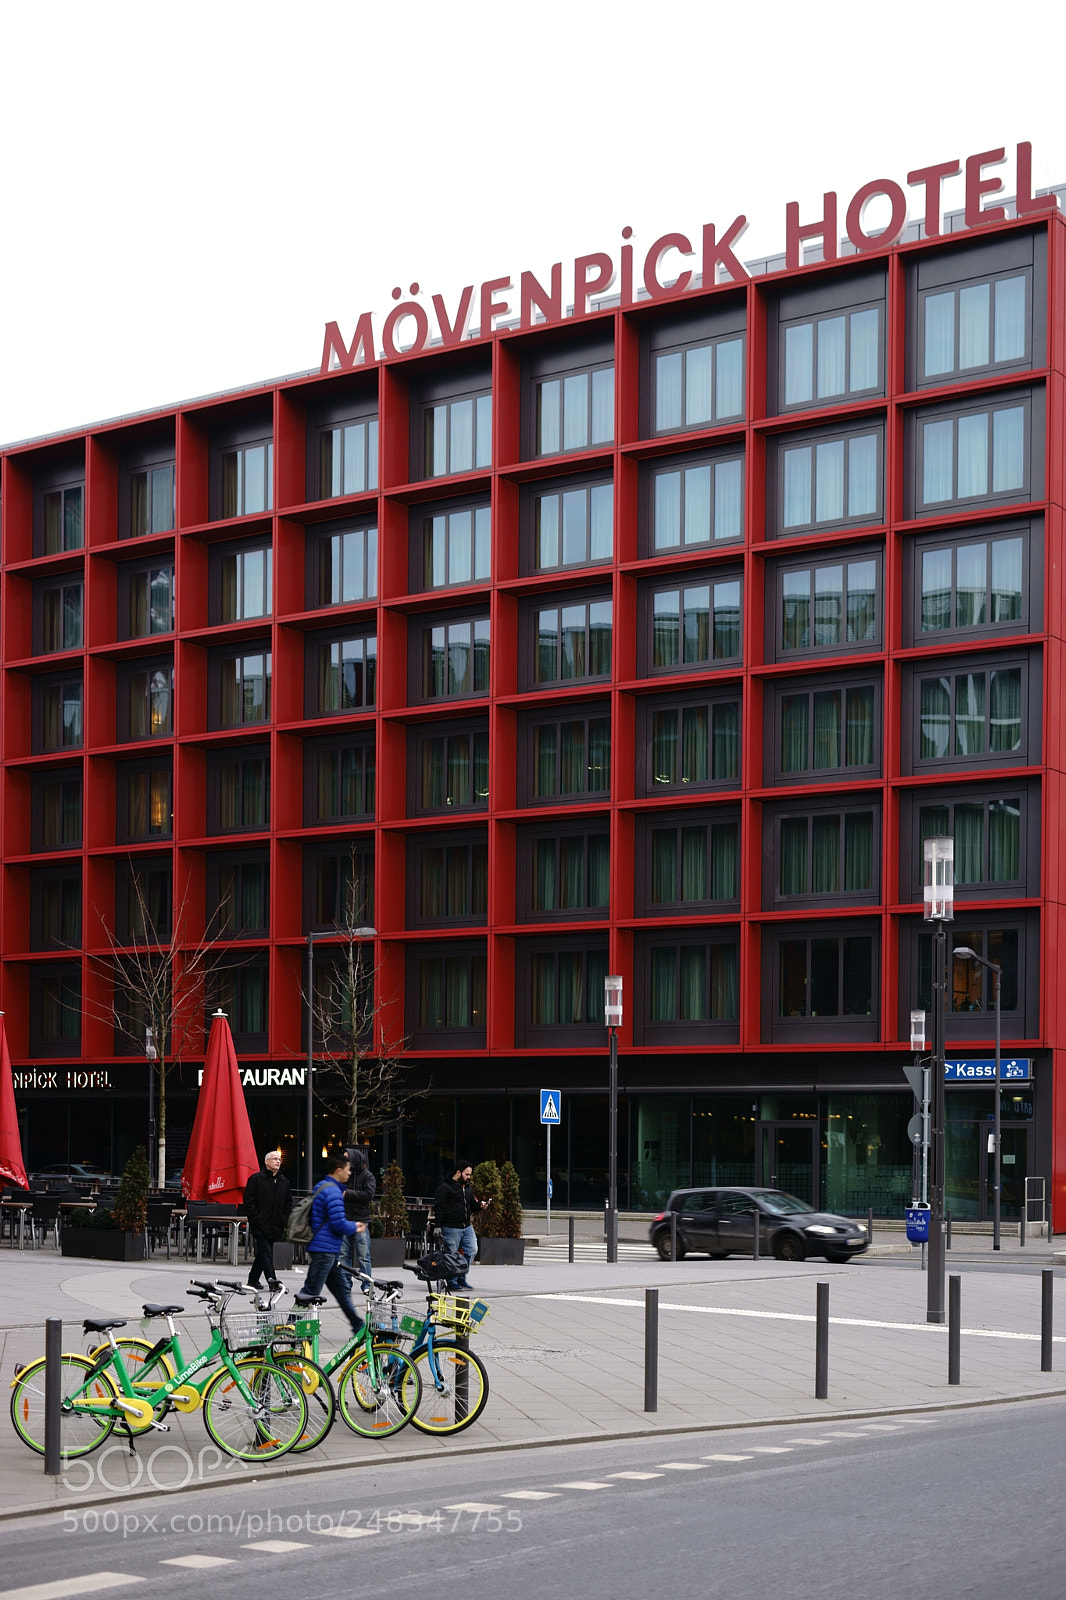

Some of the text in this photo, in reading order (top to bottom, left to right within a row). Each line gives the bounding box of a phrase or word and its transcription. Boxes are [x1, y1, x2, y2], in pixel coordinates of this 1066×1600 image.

[785, 141, 1058, 269] HOTEL
[66, 1071, 112, 1088] HOTEL
[173, 1355, 208, 1385] LimeBike
